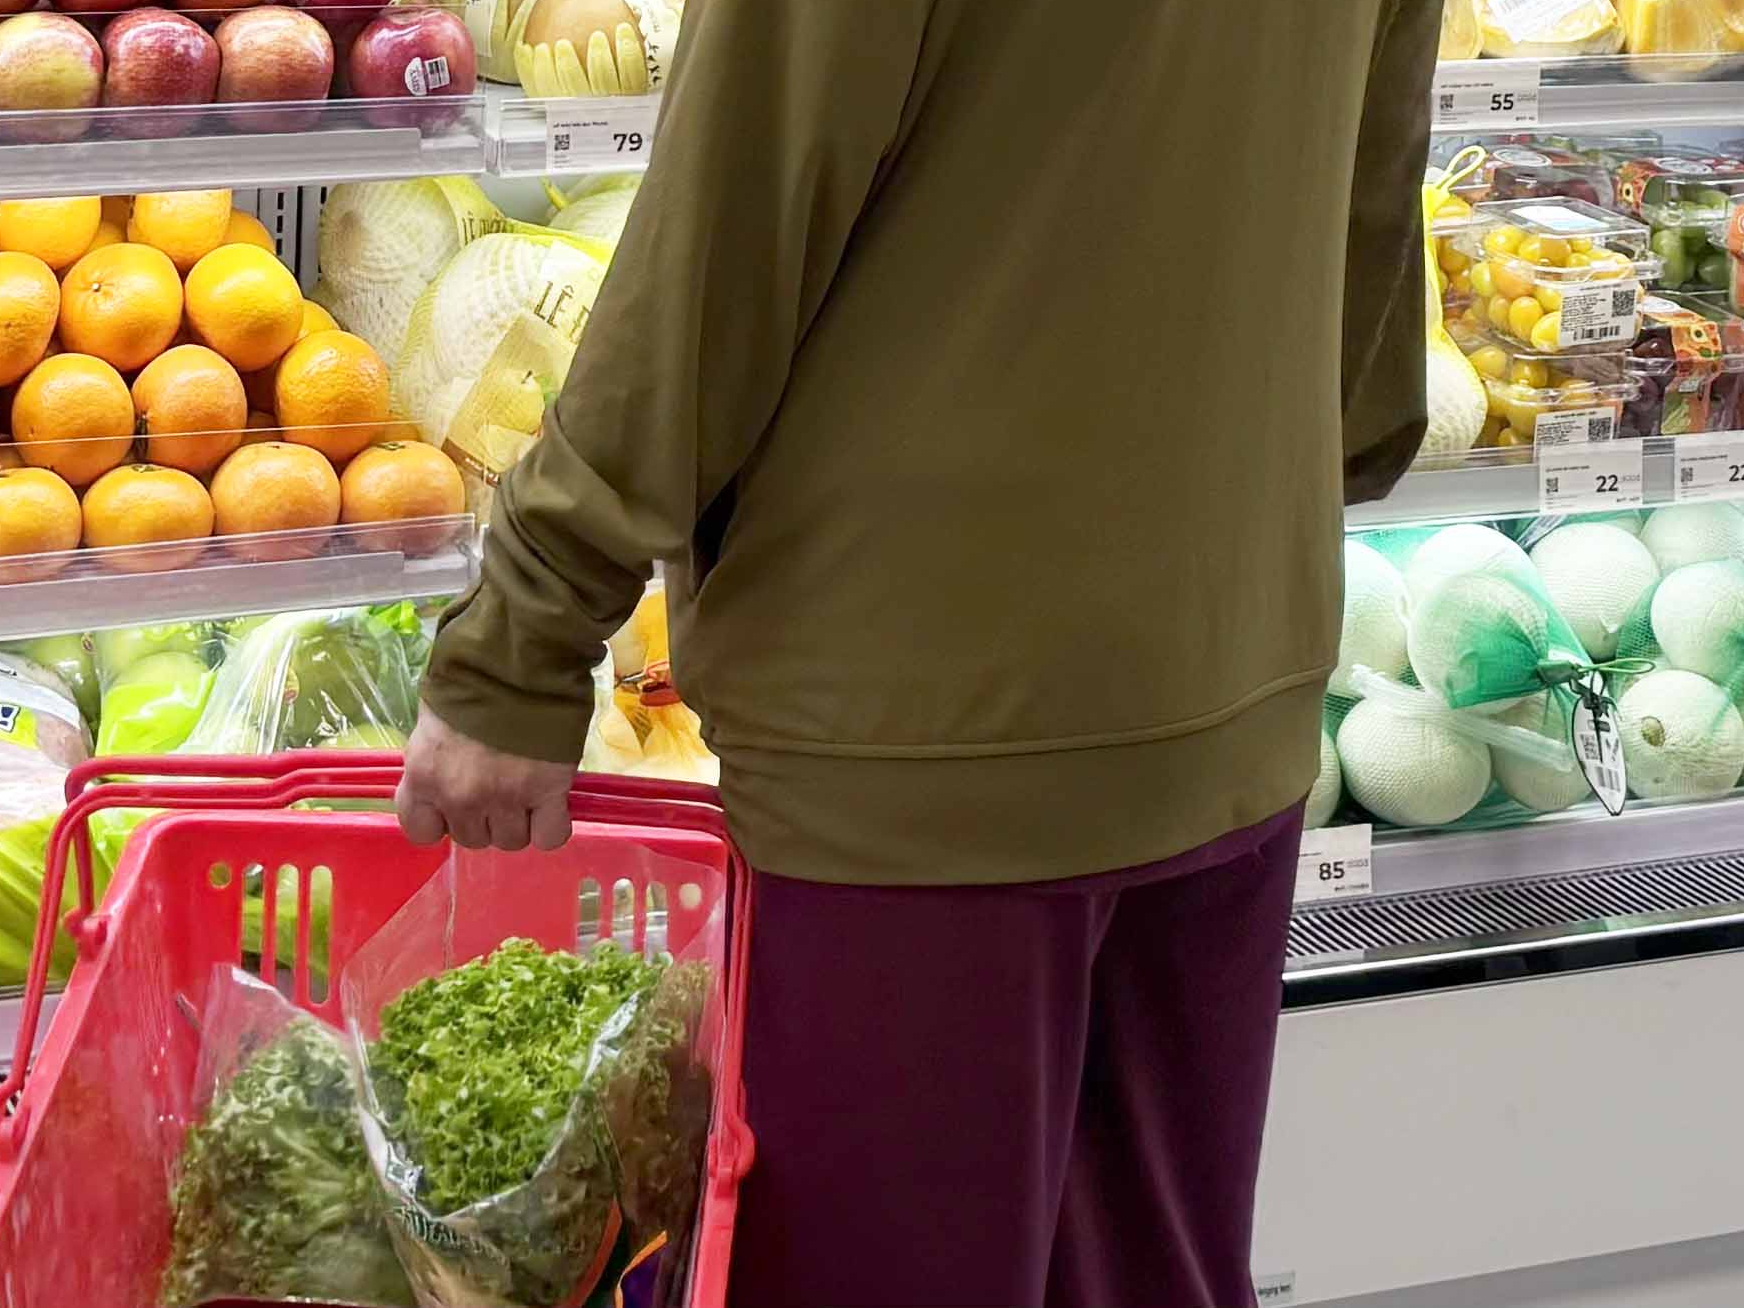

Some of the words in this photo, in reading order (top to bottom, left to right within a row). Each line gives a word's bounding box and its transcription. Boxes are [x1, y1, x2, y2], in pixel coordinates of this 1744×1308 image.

[1491, 93, 1514, 111] 55
[613, 133, 643, 152] 79
[1596, 474, 1618, 493] 22
[1319, 861, 1345, 881] 85
